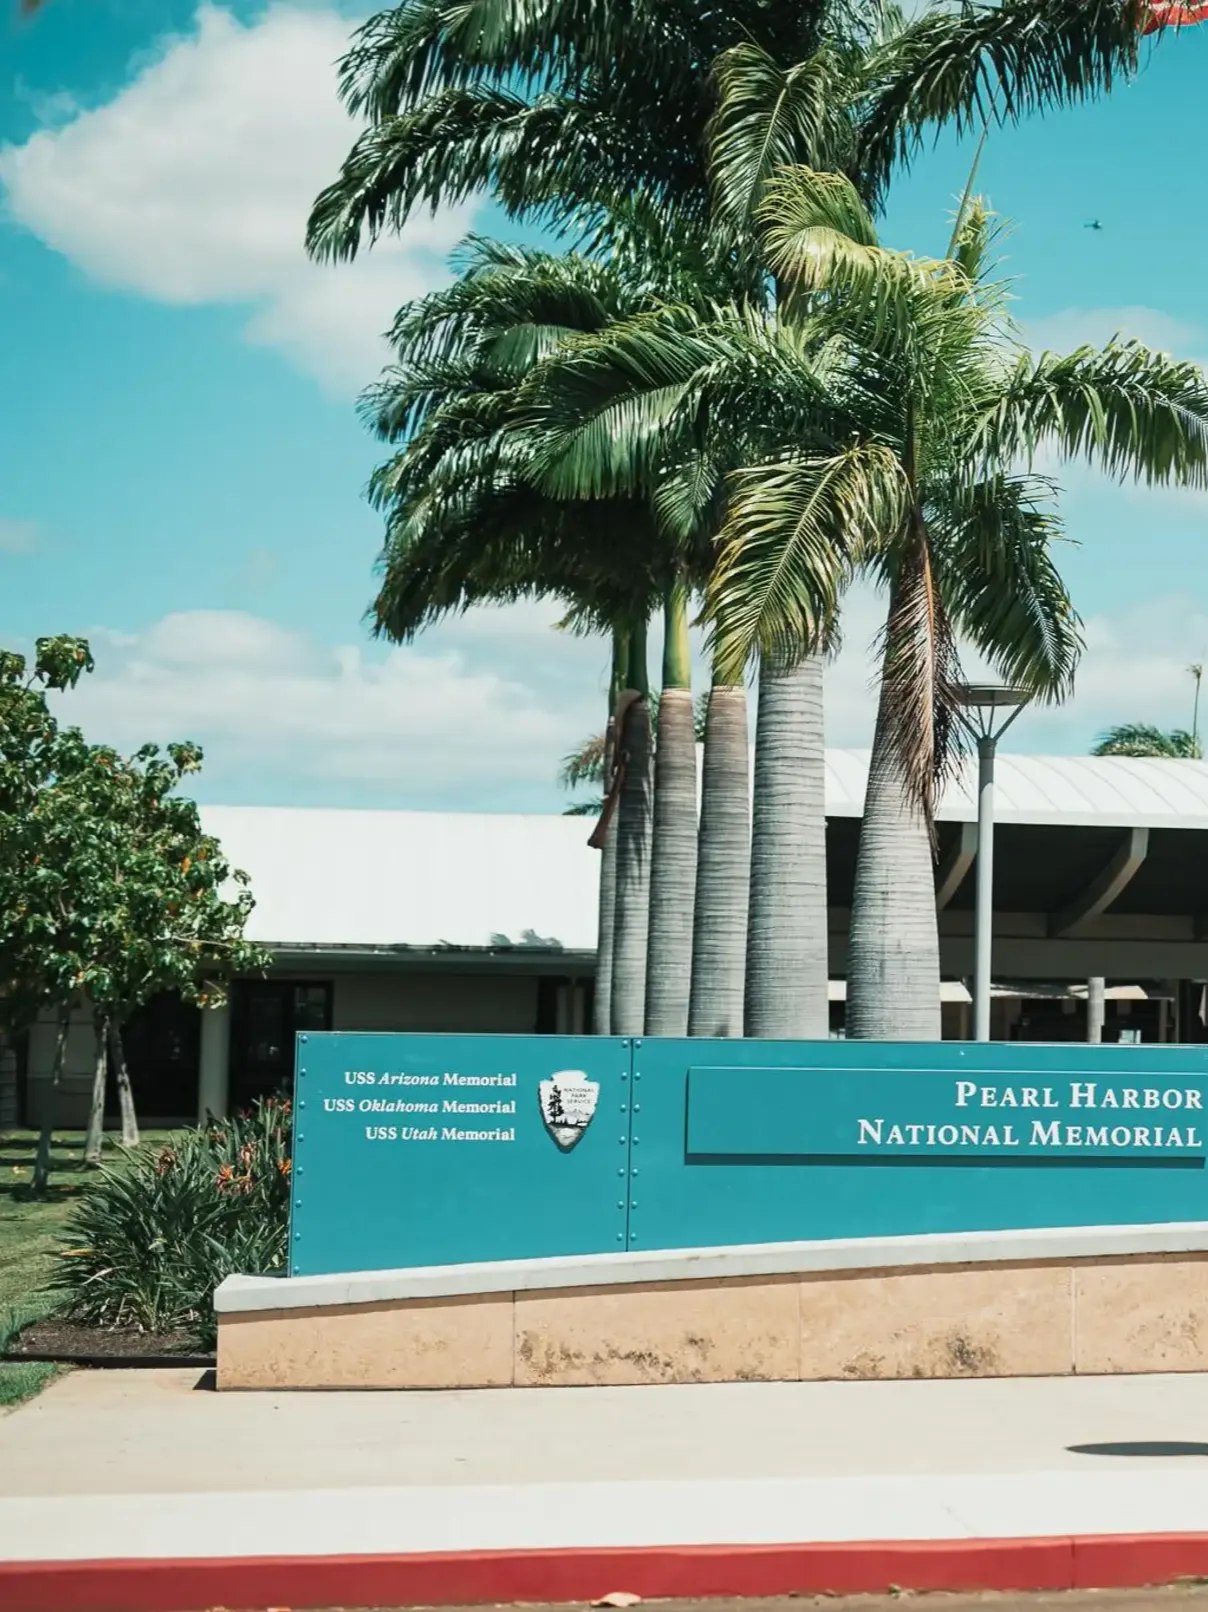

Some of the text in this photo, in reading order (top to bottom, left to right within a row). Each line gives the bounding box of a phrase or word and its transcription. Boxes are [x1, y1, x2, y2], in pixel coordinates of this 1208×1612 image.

[345, 1072, 516, 1086] USS Arizona Memorial
[955, 1081, 1203, 1109] PEARL HARBOR
[324, 1098, 515, 1114] USS Oklahoma Memorial
[366, 1127, 515, 1140] USS Utah Memorial
[857, 1119, 1202, 1147] NATIONAL MEMORIAL
